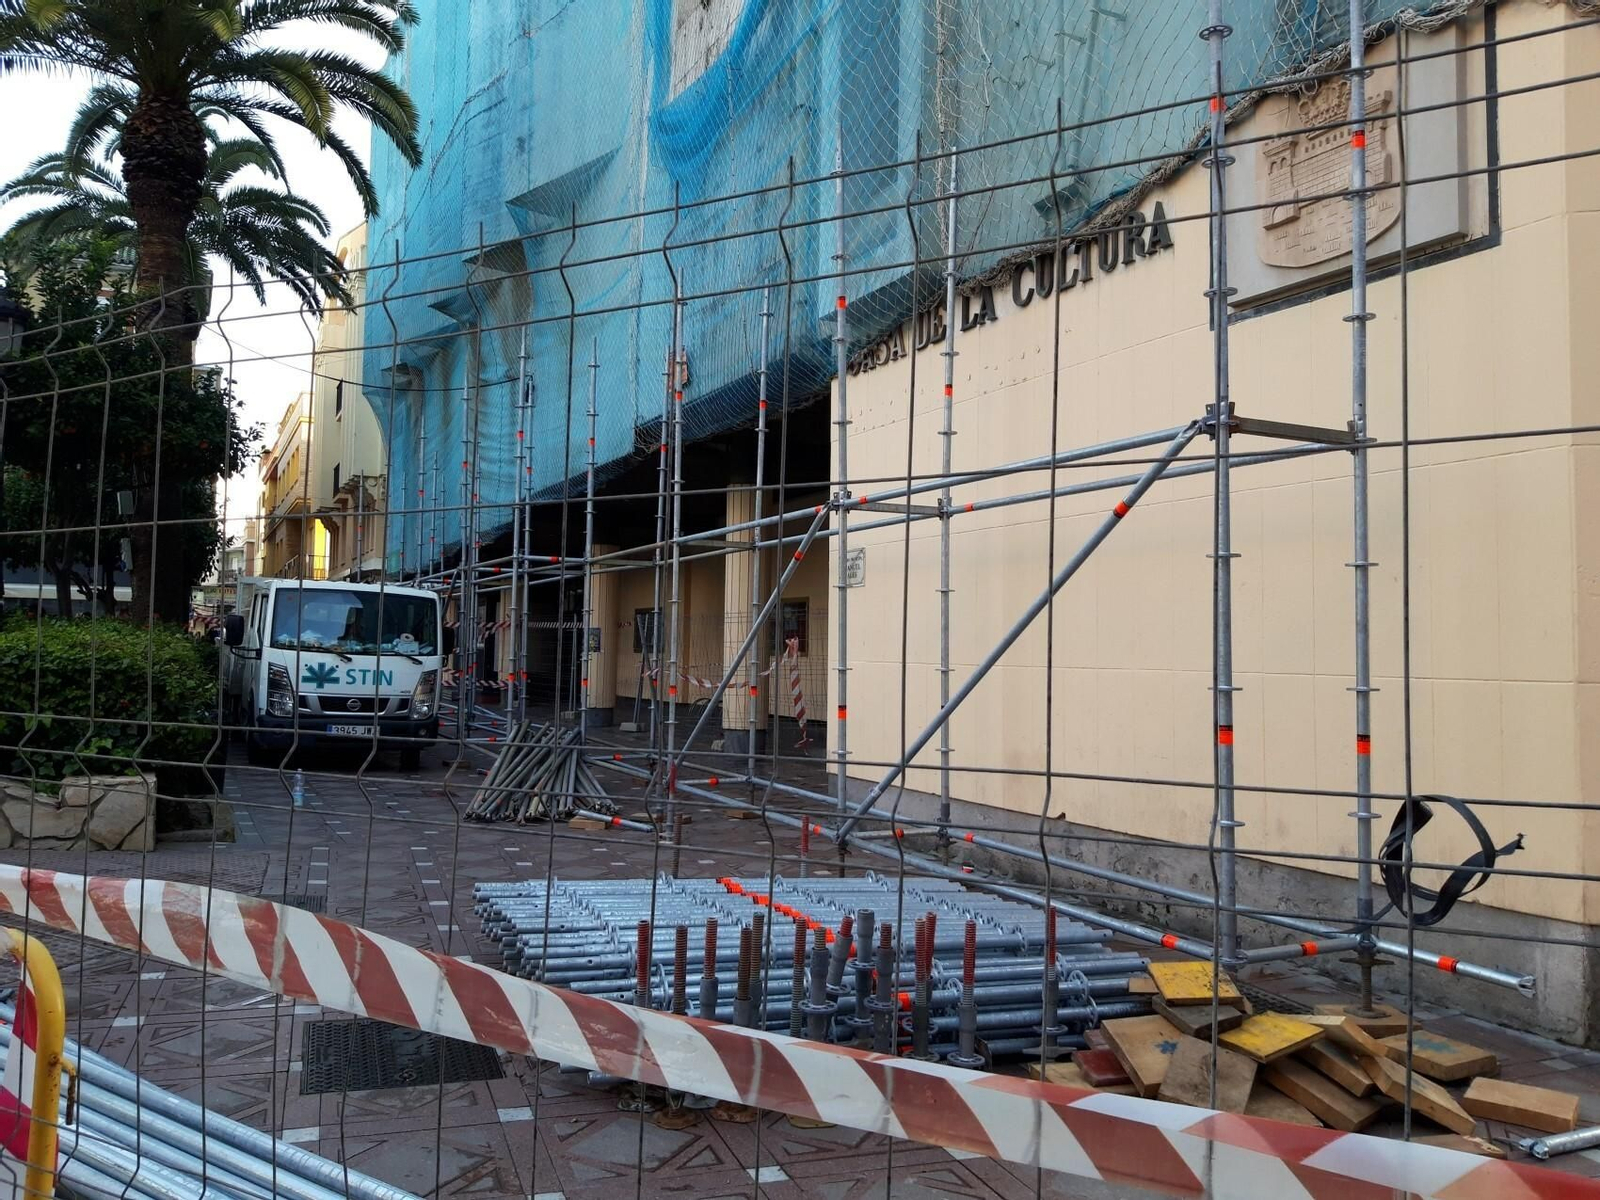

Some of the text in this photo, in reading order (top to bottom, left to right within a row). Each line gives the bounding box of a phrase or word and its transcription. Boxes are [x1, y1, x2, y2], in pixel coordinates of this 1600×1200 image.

[915, 304, 947, 351] DE
[960, 285, 998, 332] LA
[1012, 201, 1174, 307] CULTURA
[345, 668, 393, 686] STIN
